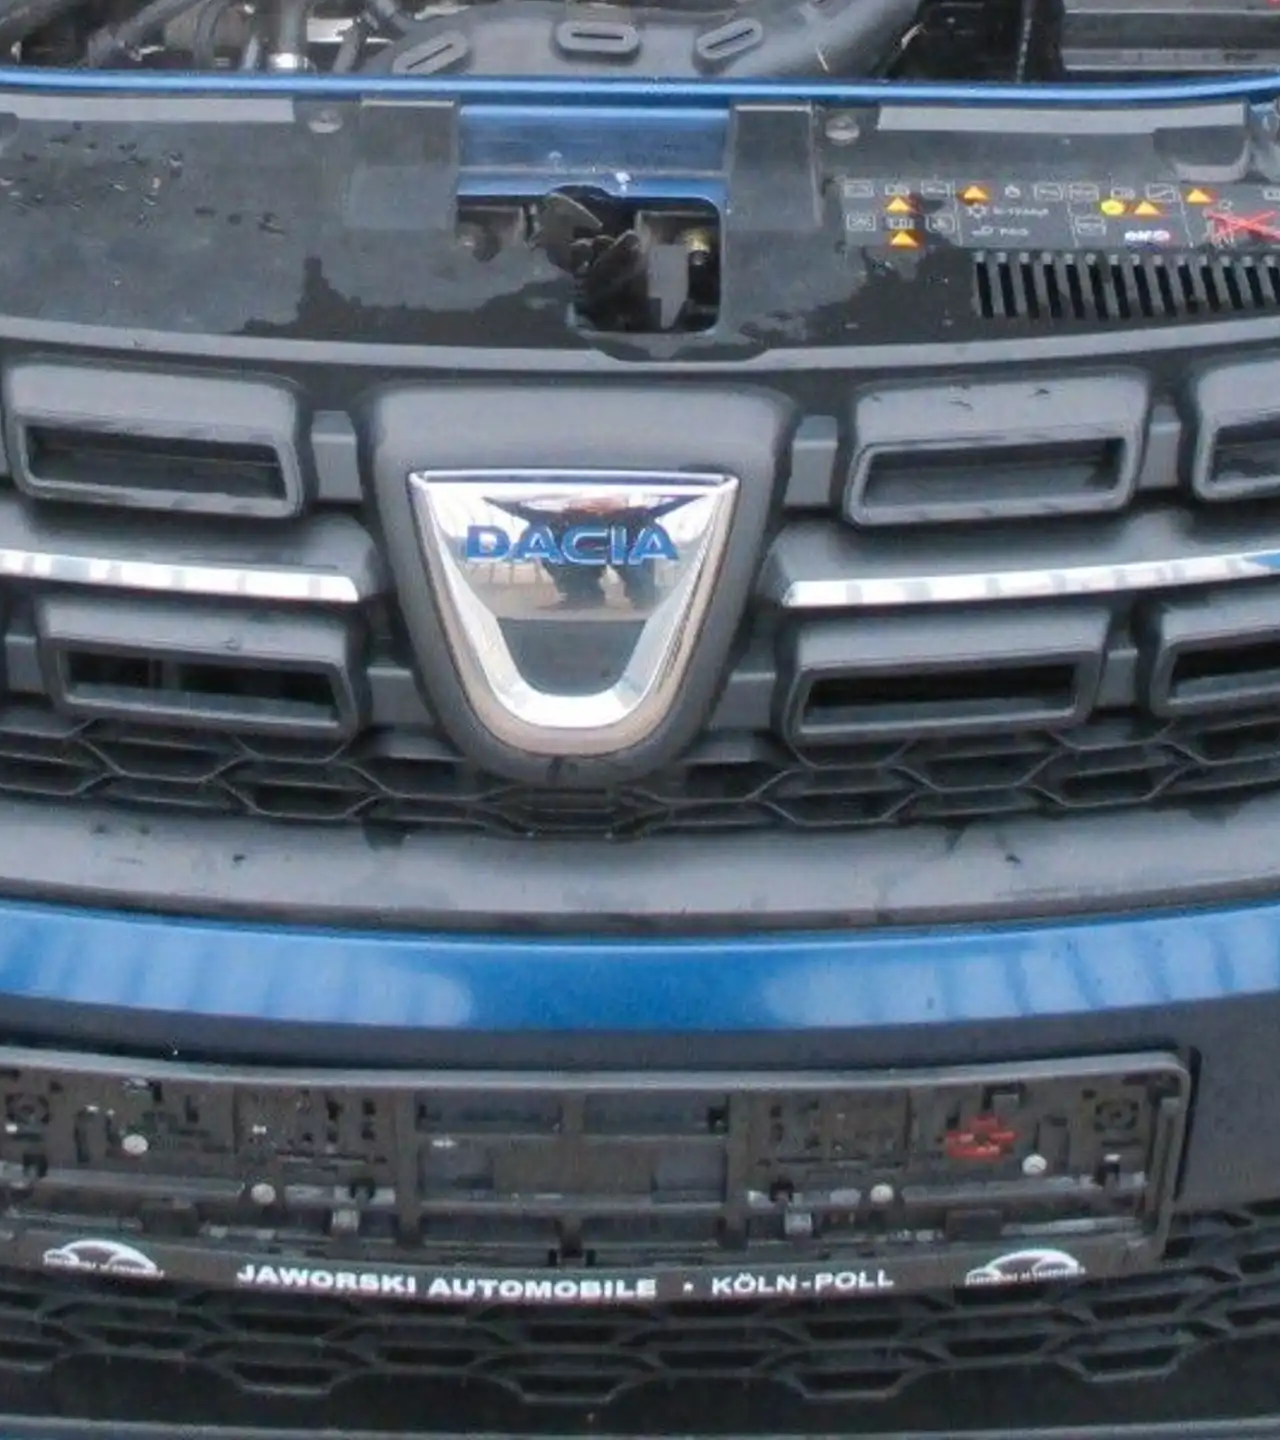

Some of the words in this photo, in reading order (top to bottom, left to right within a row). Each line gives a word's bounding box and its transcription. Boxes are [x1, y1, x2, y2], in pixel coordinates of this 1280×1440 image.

[466, 521, 679, 566] DACIA
[236, 1263, 416, 1294] JAWORSKI
[427, 1276, 657, 1299] AUTOMOBILE
[711, 1268, 896, 1295] KÖLN-POLL
